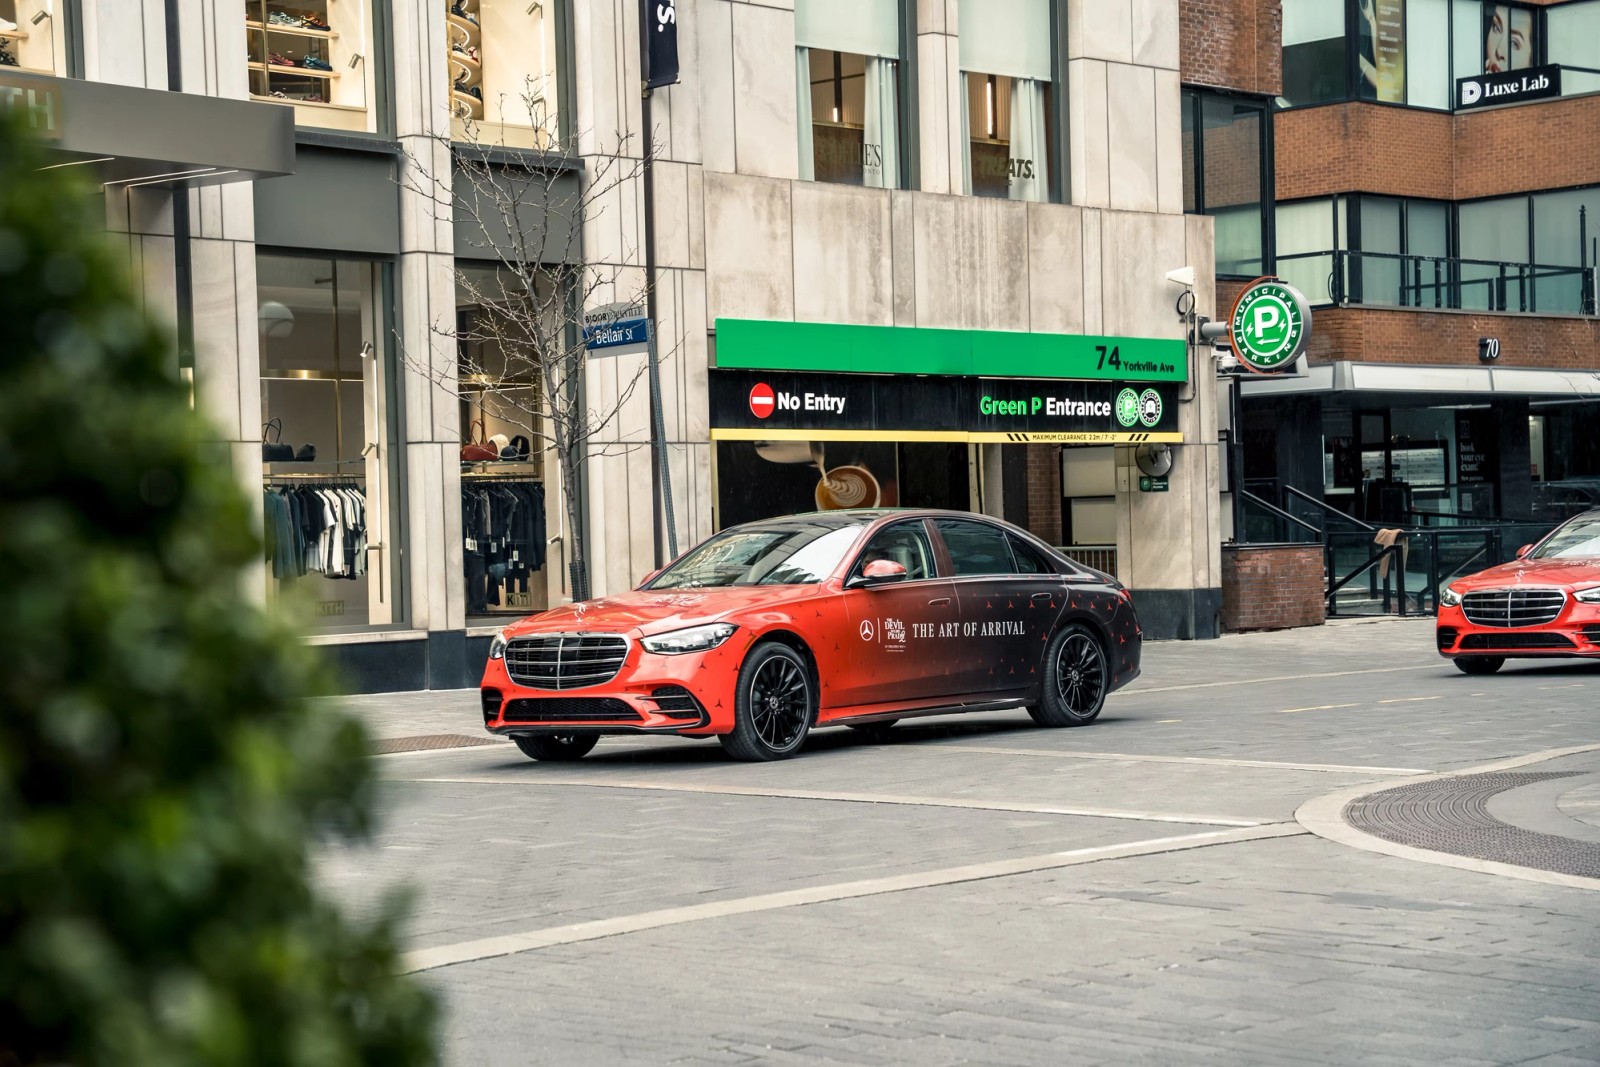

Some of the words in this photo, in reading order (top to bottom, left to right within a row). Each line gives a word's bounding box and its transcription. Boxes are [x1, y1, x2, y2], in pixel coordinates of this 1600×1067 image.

[657, 0, 675, 32] S.
[1484, 82, 1519, 98] Luxe
[1521, 74, 1549, 92] Lab
[1235, 287, 1298, 326] MUNICIPAL
[1254, 305, 1280, 338] P
[595, 327, 623, 344] Bellair
[625, 328, 633, 340] St
[1236, 329, 1298, 364] PARKING
[1095, 345, 1121, 370] 74
[1123, 361, 1158, 373] Yorkville
[1159, 362, 1175, 373] Ave
[1486, 338, 1499, 358] 70
[777, 392, 800, 410] No
[804, 392, 846, 414] Entry
[980, 395, 1028, 416] Green
[1031, 397, 1043, 415] P
[1045, 397, 1112, 417] Entrance
[316, 602, 343, 615] KITH
[884, 619, 906, 630] DEVIL
[912, 623, 935, 638] THE
[938, 622, 960, 638] ART
[963, 622, 978, 637] OF
[980, 620, 1026, 637] ARRIVAL
